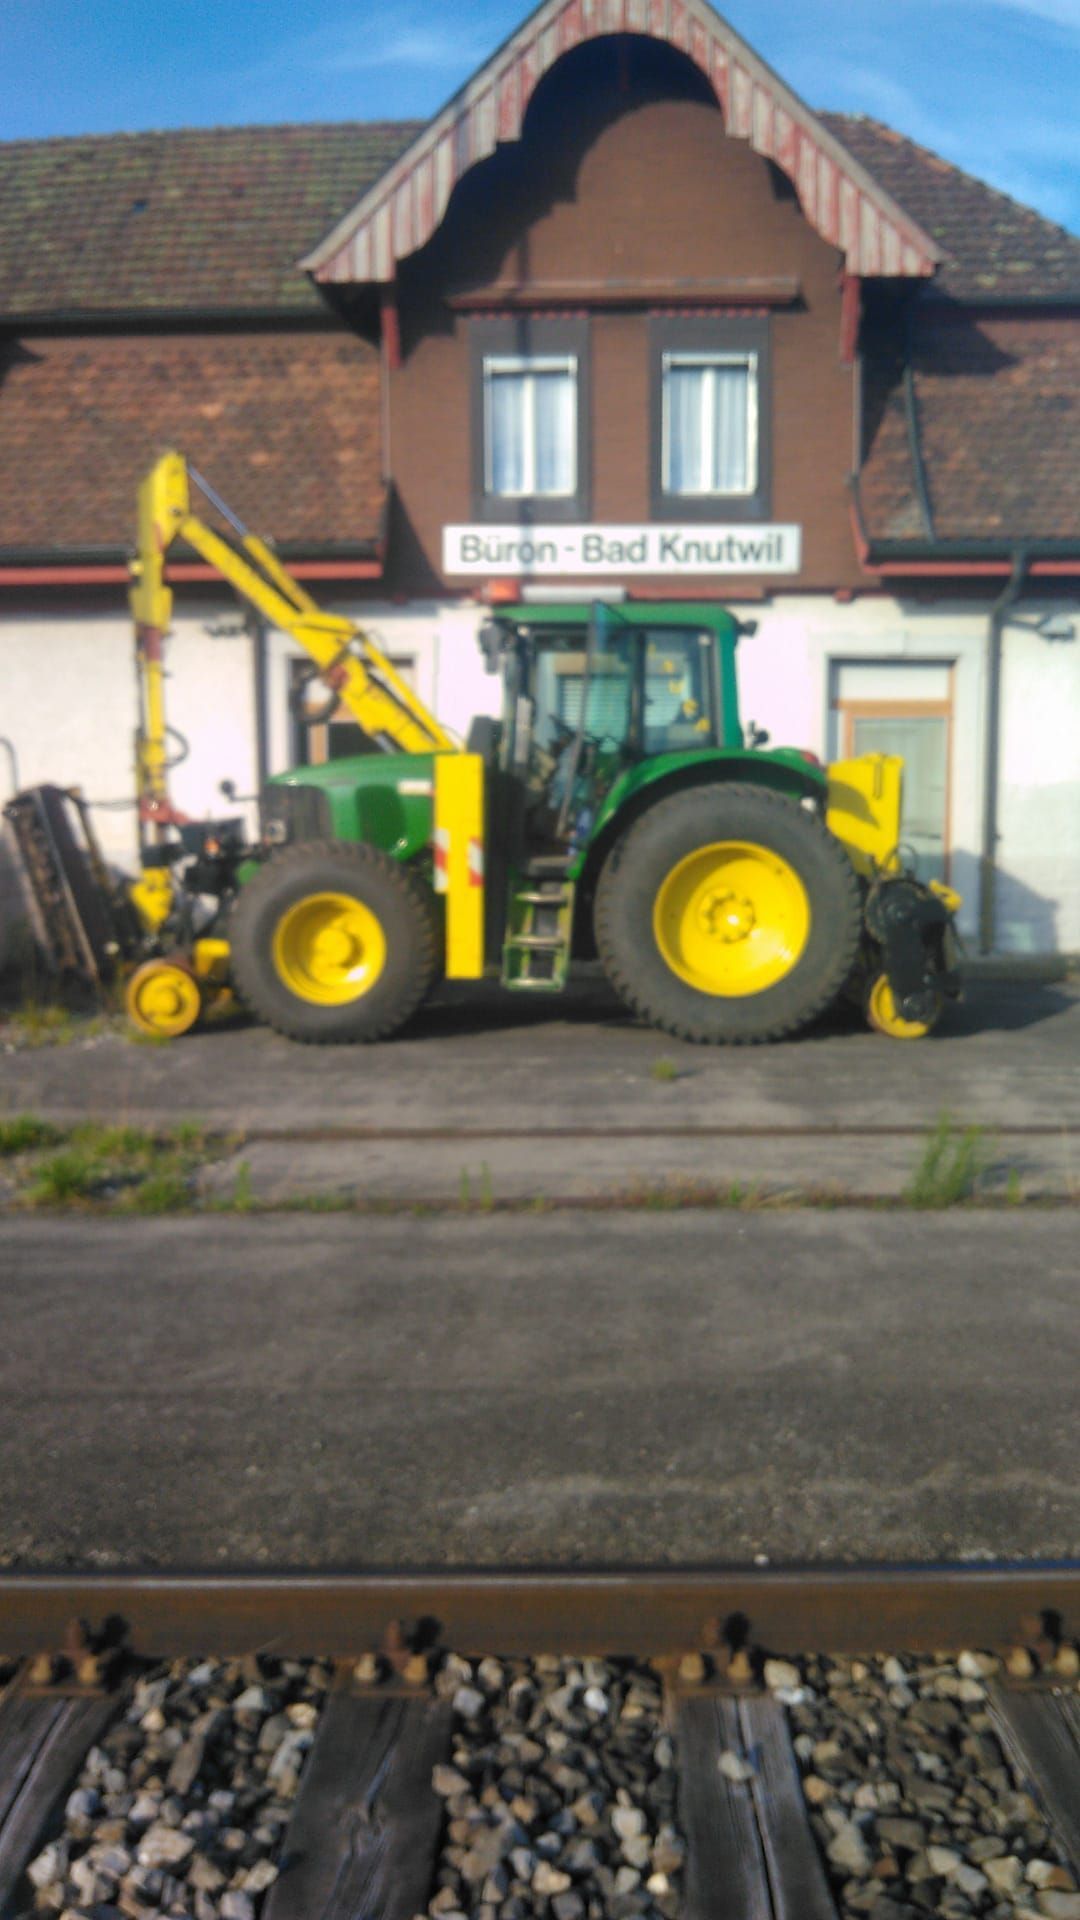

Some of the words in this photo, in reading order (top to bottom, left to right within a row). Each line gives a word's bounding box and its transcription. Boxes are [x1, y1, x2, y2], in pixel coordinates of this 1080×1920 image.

[460, 533, 557, 563] Büron
[581, 534, 648, 563] Bad
[659, 534, 783, 563] Knutwil
